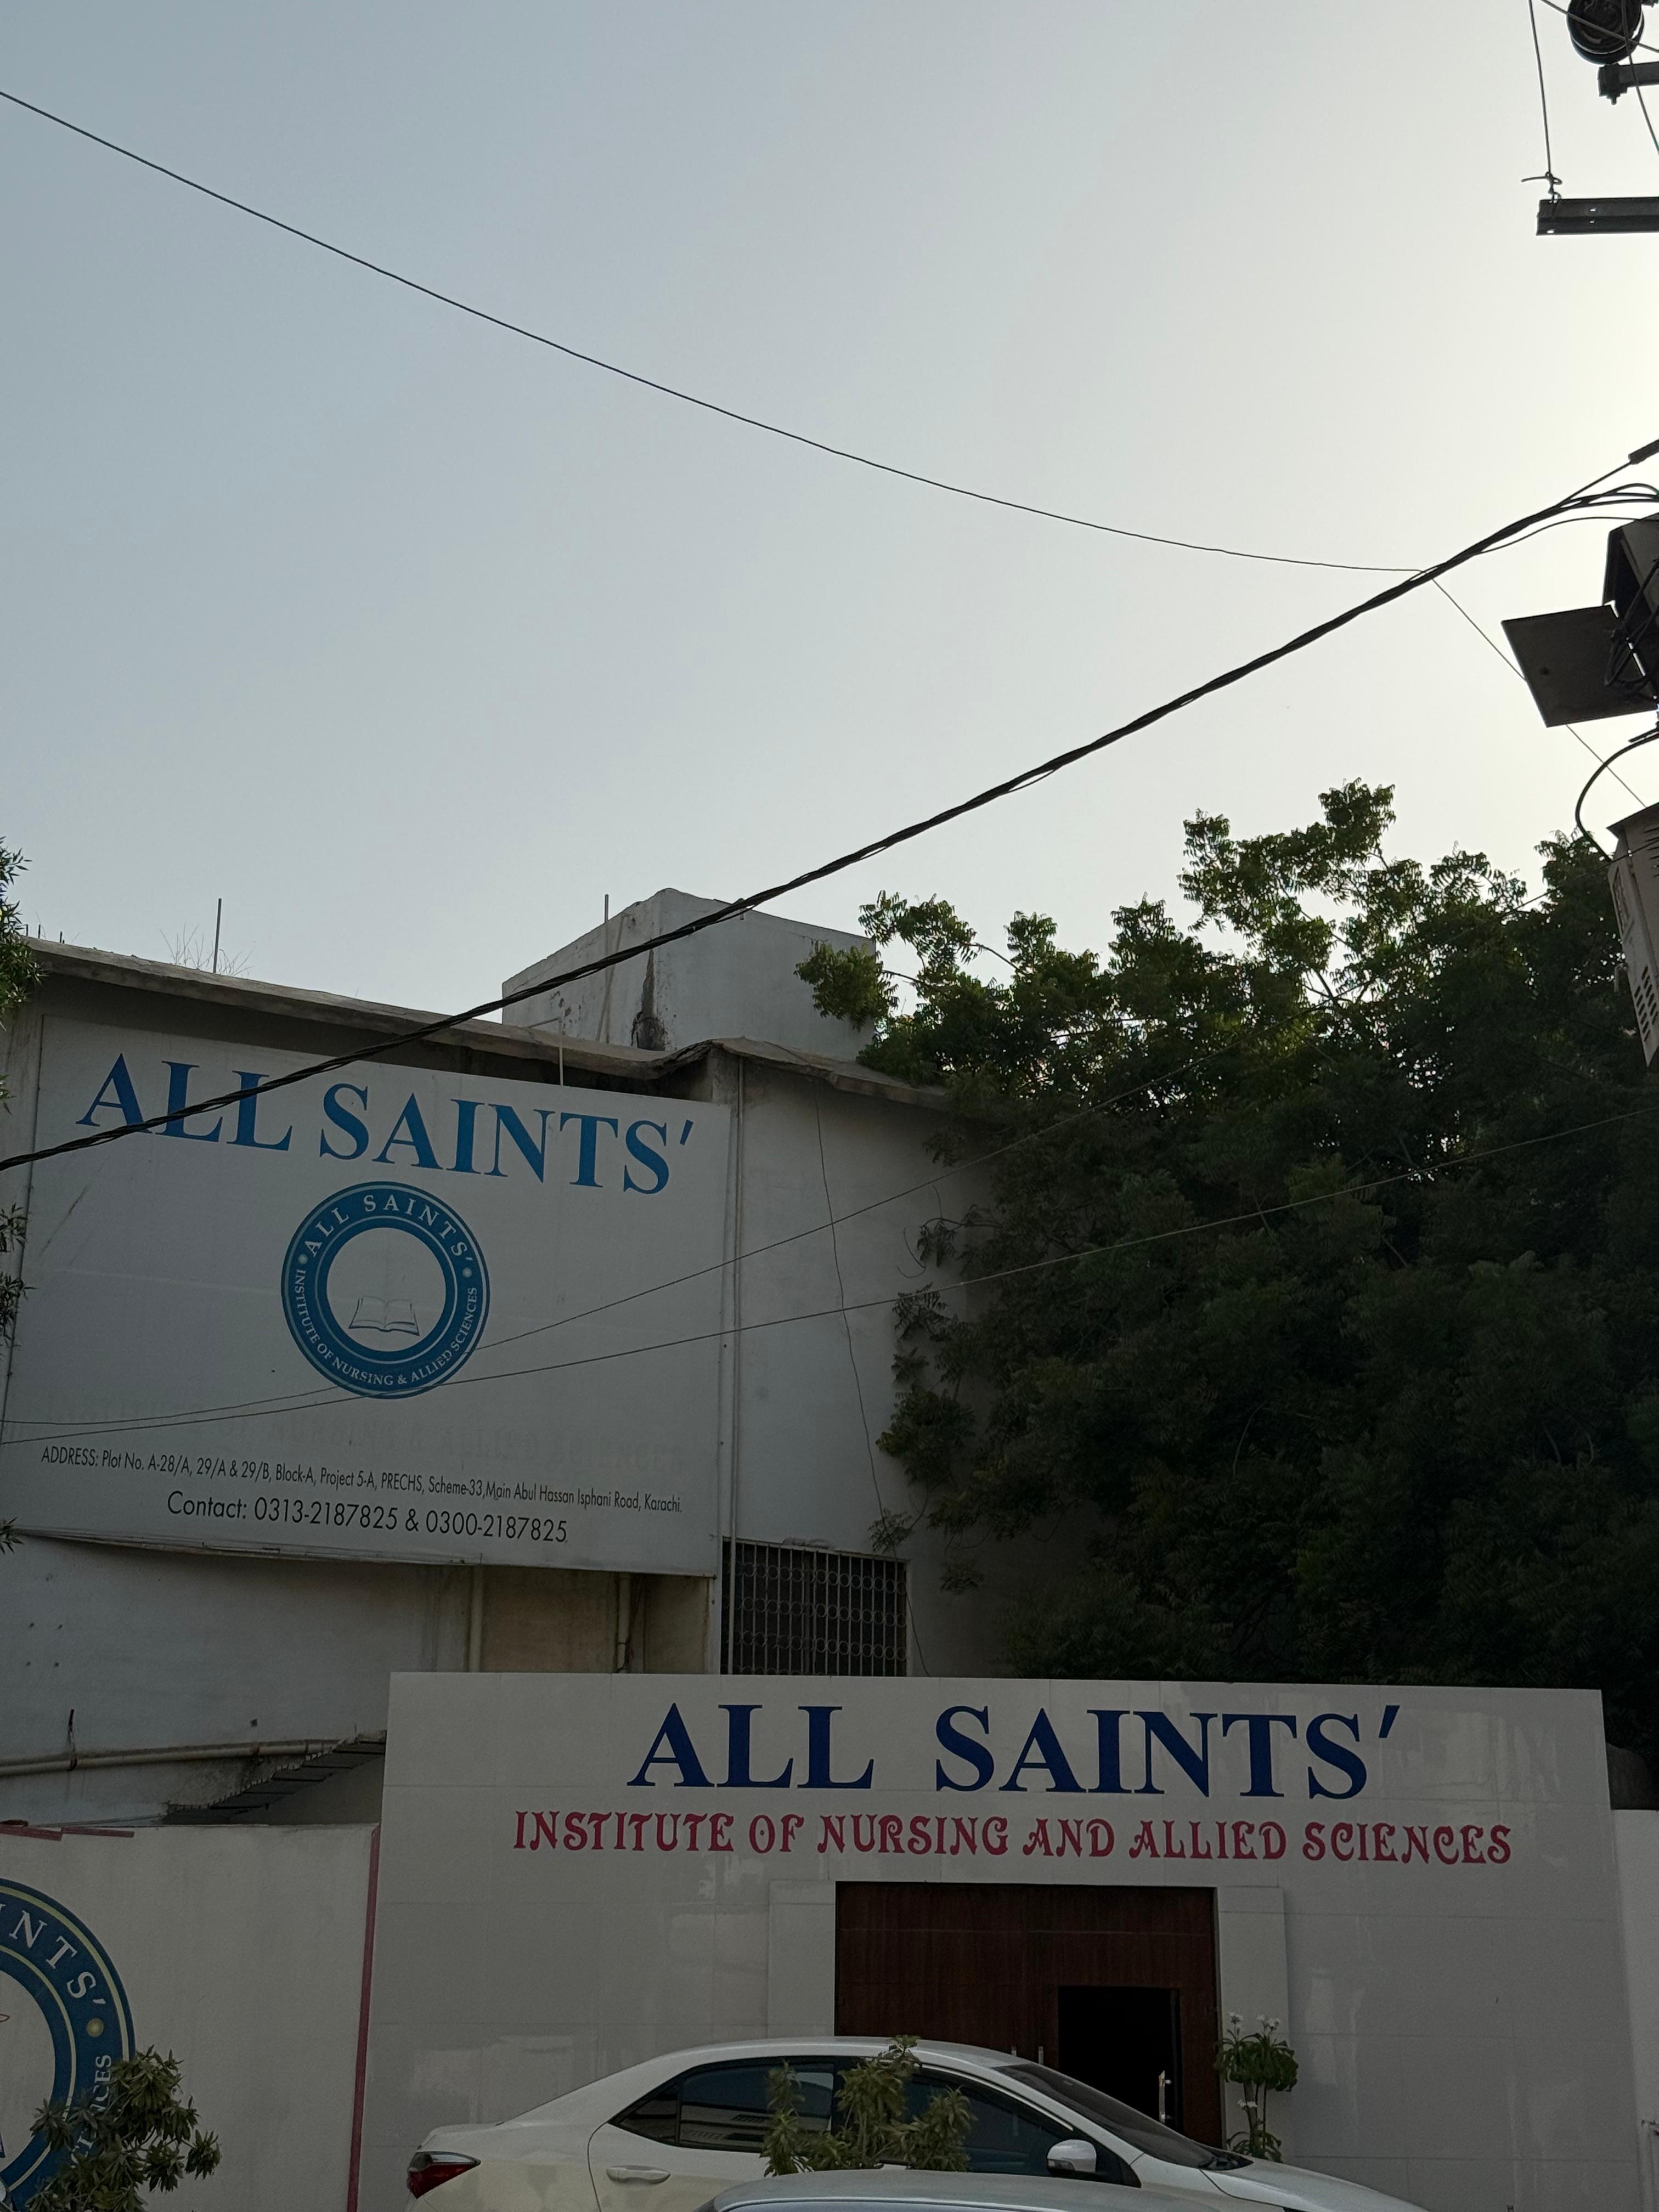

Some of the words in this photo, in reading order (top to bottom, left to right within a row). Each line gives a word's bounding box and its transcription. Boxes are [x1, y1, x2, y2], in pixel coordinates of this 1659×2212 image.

[76, 1053, 292, 1152] ALL
[319, 1083, 693, 1194] SAINTS'
[304, 1207, 349, 1257] ALL
[363, 1194, 474, 1261] SAINTS'
[294, 1269, 320, 1344] INSTITUTE
[317, 1343, 334, 1361] OF
[331, 1359, 393, 1385] NURSING
[397, 1375, 408, 1385] &
[411, 1352, 453, 1383] ALLIED
[451, 1287, 478, 1351] SCIENCES
[41, 1446, 99, 1466] ADDRESS:
[102, 1449, 122, 1468] Plot
[125, 1453, 144, 1470] No.
[148, 1453, 193, 1477] A-28/A,
[196, 1457, 226, 1479] 29/A
[229, 1460, 238, 1477] &
[241, 1460, 271, 1482] 29/B,
[276, 1463, 317, 1487] Block-A,
[320, 1468, 354, 1490] Project
[357, 1470, 377, 1491] 5-A,
[381, 1472, 425, 1494] PRECHS,
[514, 1482, 537, 1501] Abul
[540, 1485, 574, 1504] Hassan
[578, 1488, 611, 1510] Isphani
[614, 1491, 641, 1512] Road,
[645, 1493, 682, 1513] Karachi.
[167, 1491, 247, 1519] Contact:
[255, 1497, 398, 1530] 0313-2187825
[405, 1508, 419, 1532] &
[627, 1702, 874, 1790] ALL
[935, 1705, 1400, 1799] SAINTS'
[514, 1810, 734, 1852] INSTITUTE
[749, 1814, 804, 1854] OF
[817, 1815, 1008, 1856] NURSING
[1023, 1818, 1114, 1858] AND
[1129, 1821, 1286, 1859] ALLIED
[1302, 1822, 1511, 1865] SCIENCES
[0, 1903, 106, 2004] NTS'
